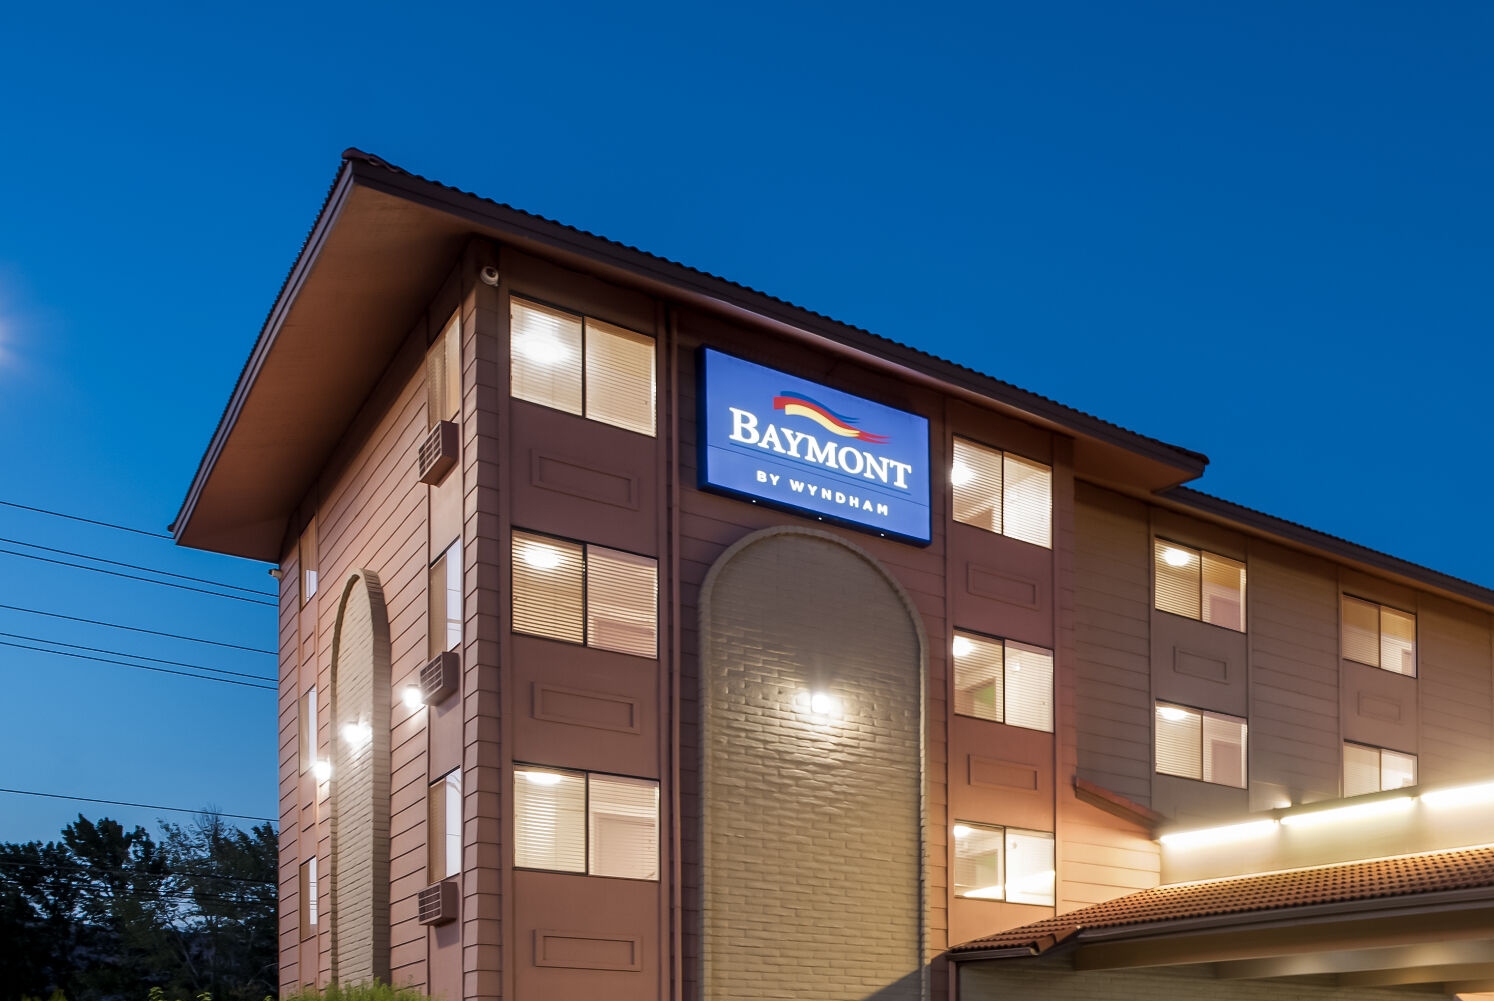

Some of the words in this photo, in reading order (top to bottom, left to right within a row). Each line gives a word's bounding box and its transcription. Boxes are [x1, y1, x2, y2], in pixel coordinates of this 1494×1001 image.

[728, 406, 912, 489] BAYMONT
[756, 470, 780, 486] BY
[789, 478, 888, 516] WYNDHAM
